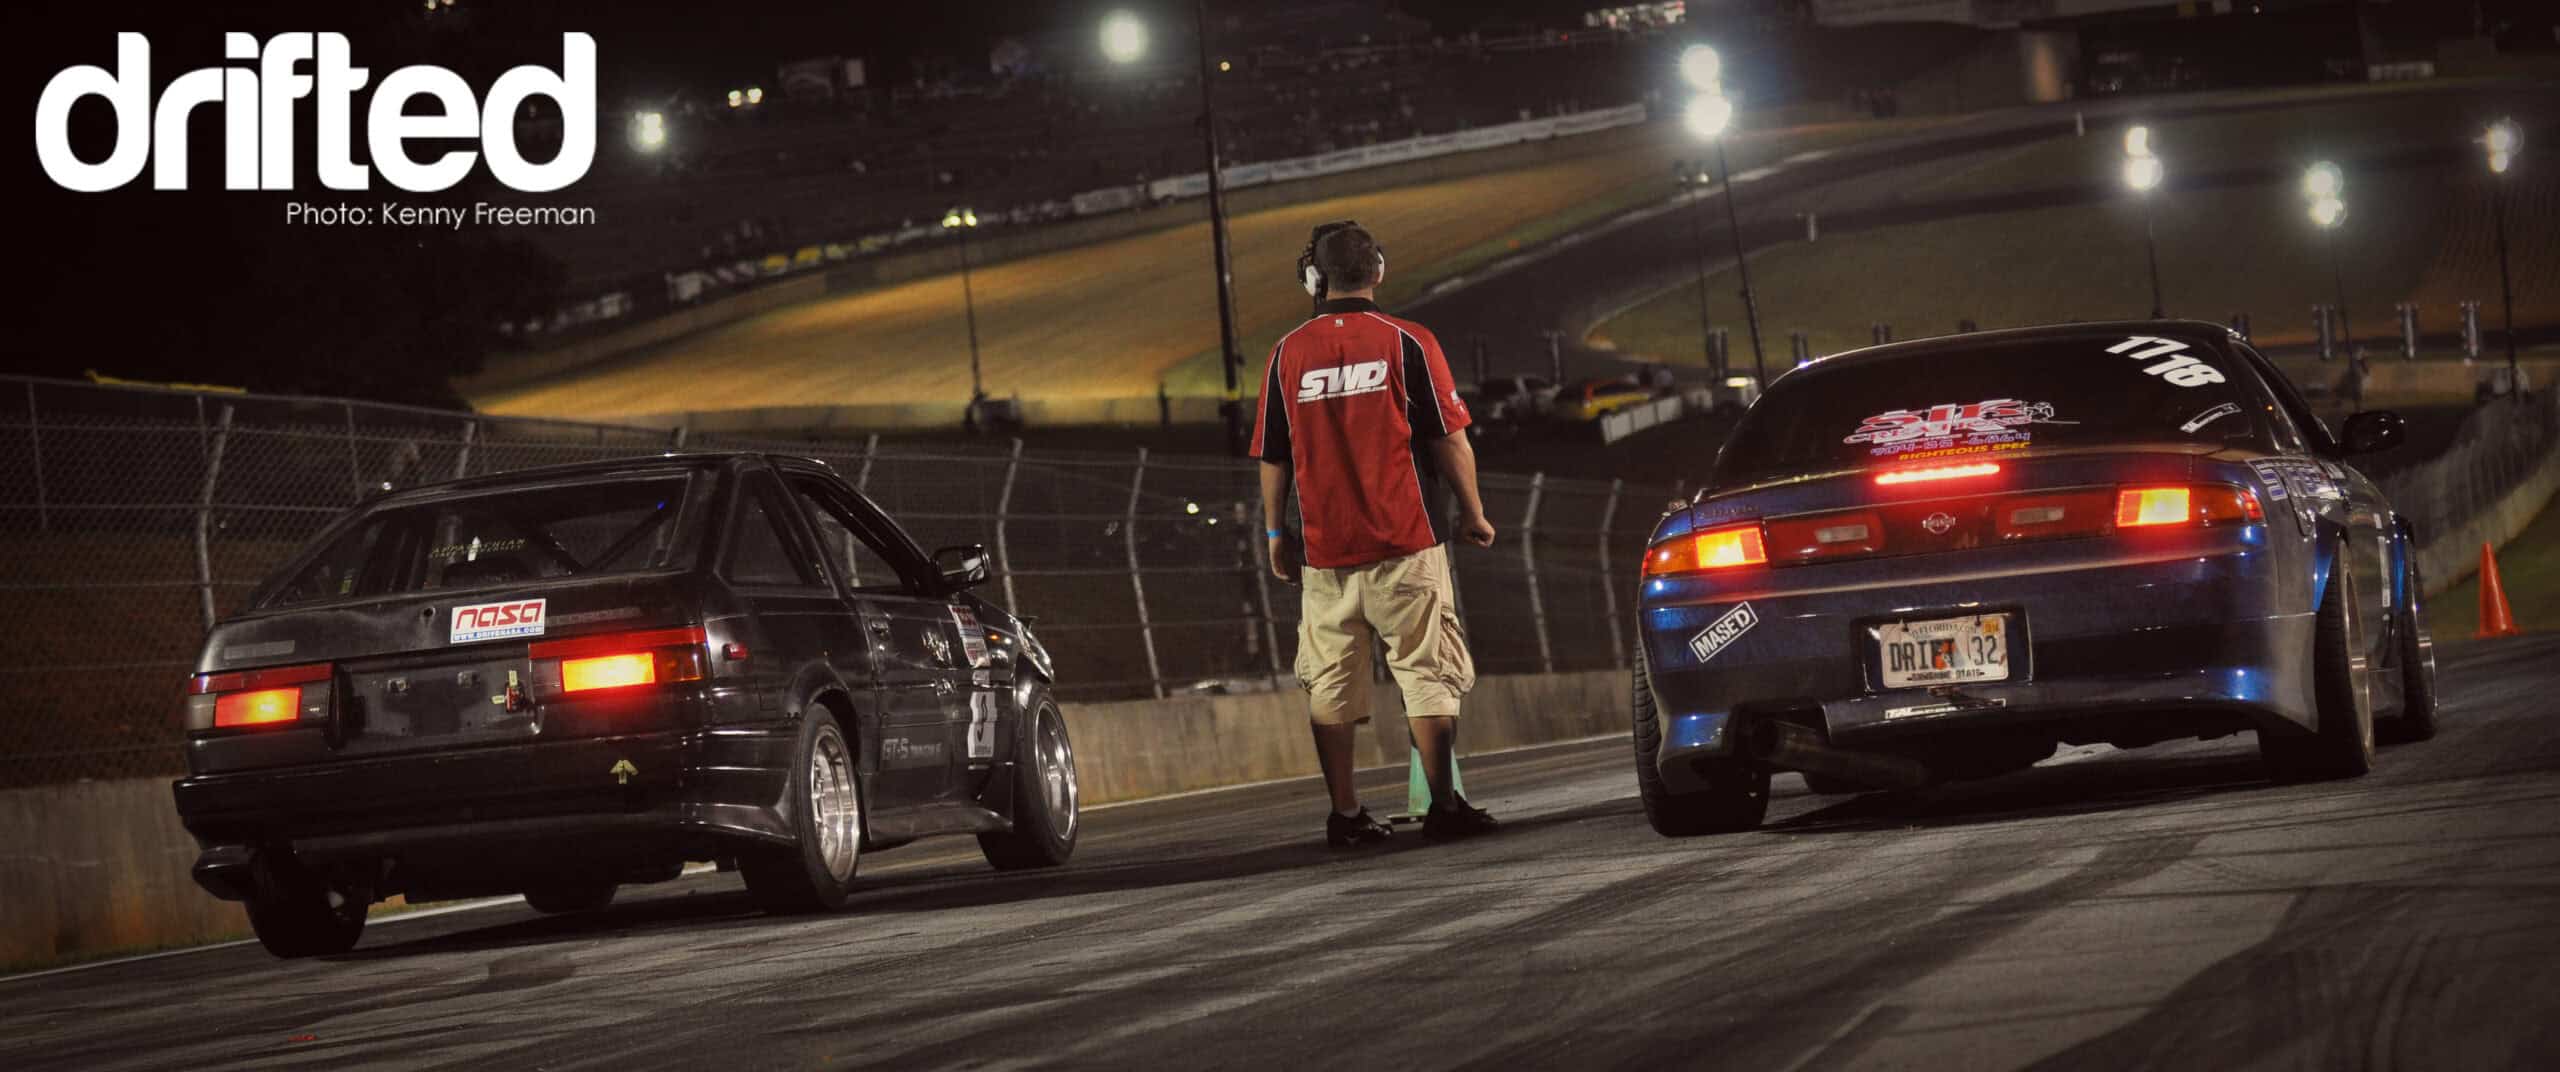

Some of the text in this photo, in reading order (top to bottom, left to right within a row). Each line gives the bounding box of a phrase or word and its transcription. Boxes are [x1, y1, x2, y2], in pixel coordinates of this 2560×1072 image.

[2104, 336, 2226, 388] 1718
[1299, 361, 1388, 398] SWD
[1899, 444, 1988, 460] RIGHTEOUS
[1971, 635, 2000, 666] 32
